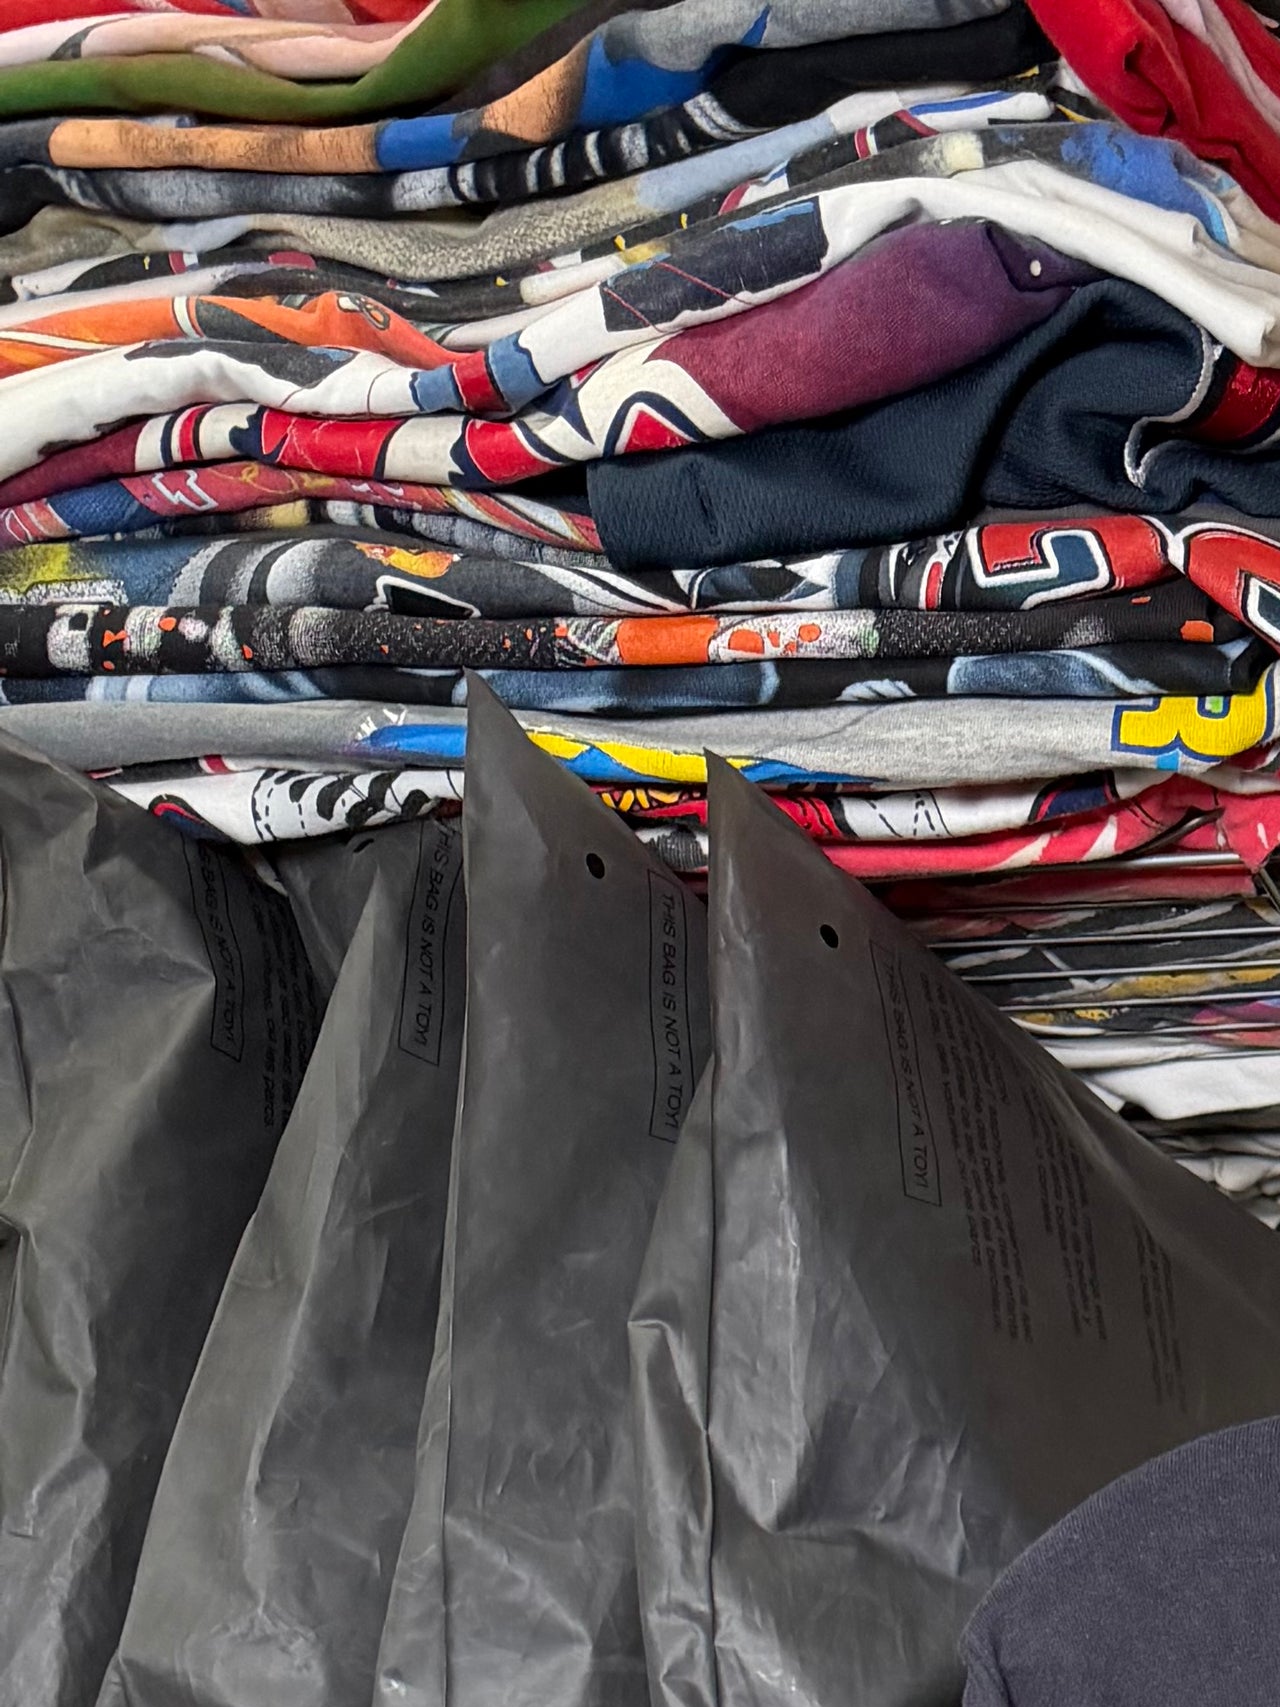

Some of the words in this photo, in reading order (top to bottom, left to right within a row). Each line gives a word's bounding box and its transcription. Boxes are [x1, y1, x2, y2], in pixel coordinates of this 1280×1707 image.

[425, 867, 444, 912] BAG
[422, 917, 435, 937] IS
[662, 895, 676, 937] THIS
[420, 939, 435, 980] NOT
[662, 941, 677, 987] BAG
[419, 983, 433, 995] A
[662, 992, 676, 1012] IS
[664, 1016, 681, 1056] NOT
[668, 1060, 682, 1076] A
[664, 1085, 683, 1130] TOY!
[911, 1121, 925, 1138] A
[911, 1144, 930, 1189] TOY!
